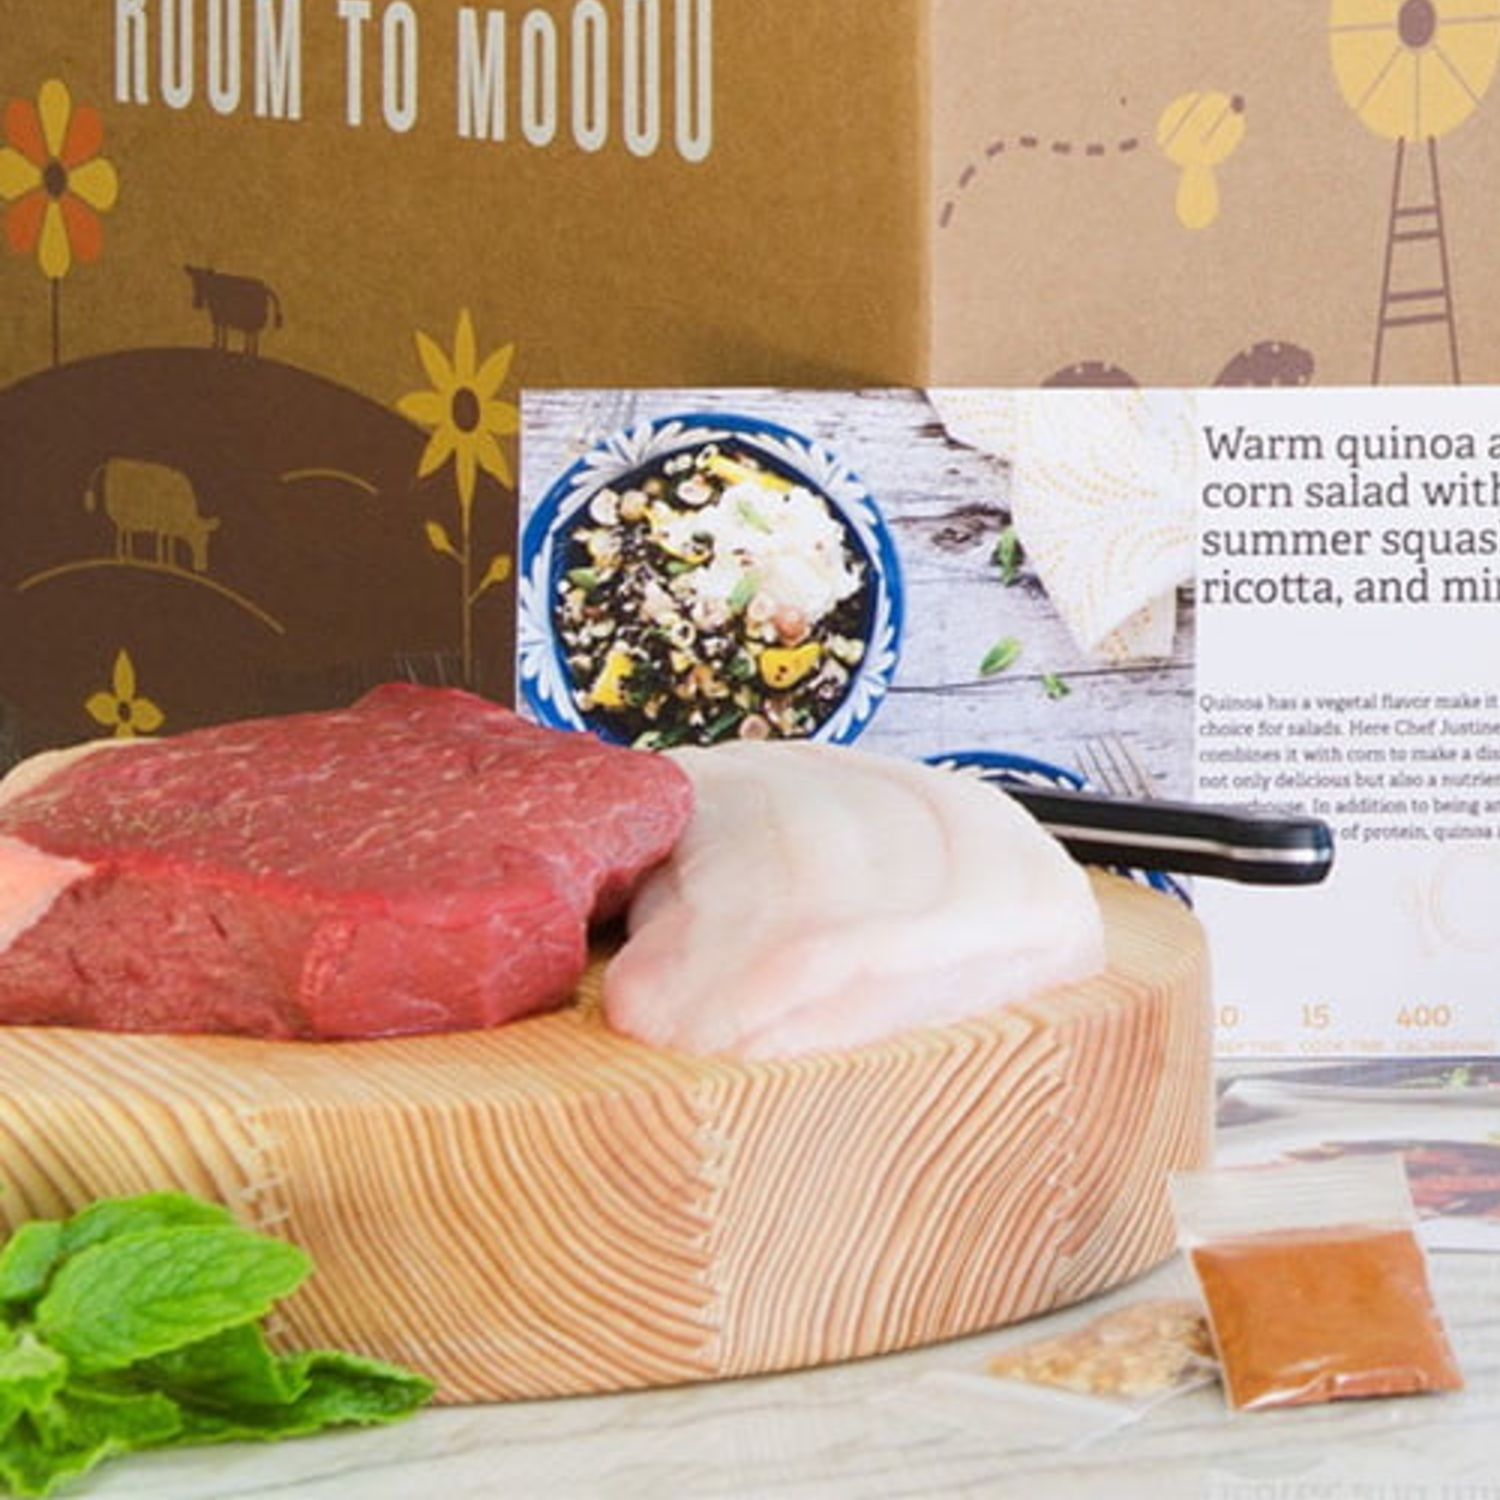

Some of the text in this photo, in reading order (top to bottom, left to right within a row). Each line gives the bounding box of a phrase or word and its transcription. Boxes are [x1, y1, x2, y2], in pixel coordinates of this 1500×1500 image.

[1203, 426, 1324, 460] Warm
[1336, 425, 1476, 468] quinoa
[1202, 481, 1293, 509] corn
[1304, 472, 1410, 509] salad
[1202, 527, 1371, 556] summer
[1203, 569, 1343, 607] ricotta,
[1354, 568, 1428, 604] and
[1200, 695, 1262, 712] Quinoa
[1268, 695, 1296, 709] has
[1302, 698, 1311, 709] a
[1316, 694, 1377, 712] vegetal
[1382, 694, 1430, 709] flavor
[1435, 694, 1480, 709] make
[1485, 695, 1498, 709] it
[1200, 721, 1253, 735] choice
[1257, 720, 1283, 735] for
[1288, 720, 1343, 735] salads.
[1350, 720, 1390, 735] Here
[1394, 719, 1436, 735] Chef
[1200, 748, 1280, 762] combines
[1286, 748, 1297, 762] it
[1303, 747, 1342, 761] with
[1347, 750, 1386, 761] corn
[1390, 748, 1406, 761] to
[1411, 746, 1457, 760] make
[1461, 749, 1471, 760] a
[1200, 774, 1228, 788] not
[1232, 773, 1271, 791] only
[1275, 772, 1350, 787] delicious
[1355, 772, 1384, 787] but
[1390, 772, 1423, 787] also
[1428, 776, 1437, 787] a
[1313, 799, 1332, 813] In
[1336, 798, 1407, 813] addition
[1412, 799, 1429, 813] to
[1434, 798, 1480, 816] being
[1341, 824, 1360, 840] of
[1362, 825, 1429, 842] protein,
[1433, 824, 1492, 842] quinoa
[1302, 1004, 1330, 1028] 15
[1396, 1004, 1451, 1028] 400
